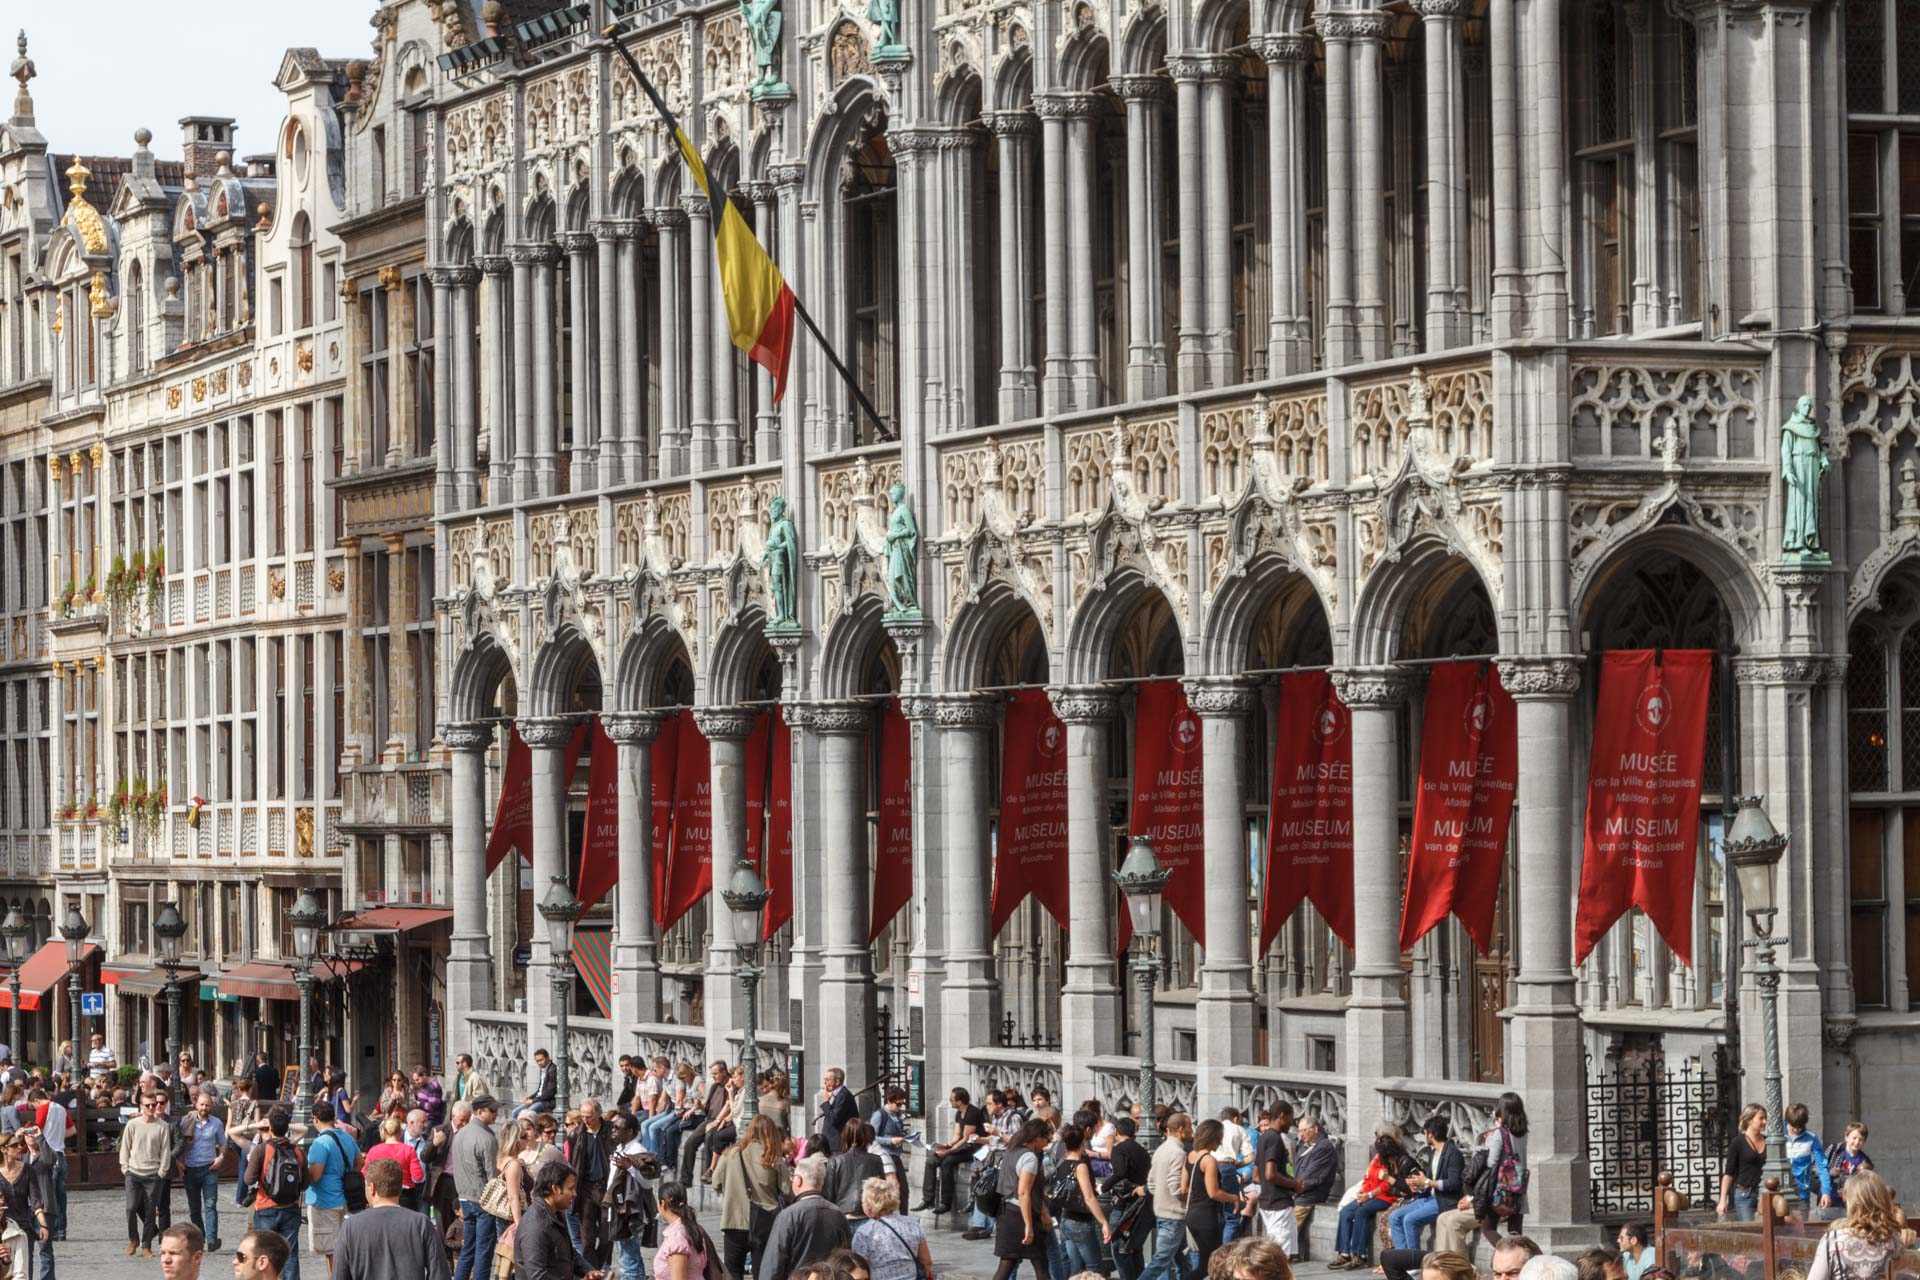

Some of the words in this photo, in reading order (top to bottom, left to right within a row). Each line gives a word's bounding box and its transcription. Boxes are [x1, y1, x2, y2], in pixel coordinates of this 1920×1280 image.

[1619, 750, 1678, 774] MUSÉE
[1296, 760, 1350, 782] MUSÉE
[1424, 780, 1438, 791] de
[1440, 780, 1450, 791] la
[1452, 782, 1474, 793] Ville
[1594, 776, 1607, 787] de
[1609, 776, 1620, 787] la
[1622, 775, 1643, 786] Ville
[1645, 778, 1658, 789] de
[1138, 791, 1150, 802] de
[1160, 789, 1176, 800] Ville
[1615, 792, 1649, 805] Maison
[1661, 792, 1676, 804] Roi
[777, 799, 788, 807] de
[1281, 818, 1351, 838] MUSEUM
[1605, 817, 1679, 838] MUSEUM
[1302, 838, 1321, 850] Stad
[1424, 842, 1443, 852] van
[1445, 842, 1459, 853] de
[1597, 842, 1617, 852] van
[1618, 840, 1631, 851] de
[1631, 839, 1654, 853] Stad
